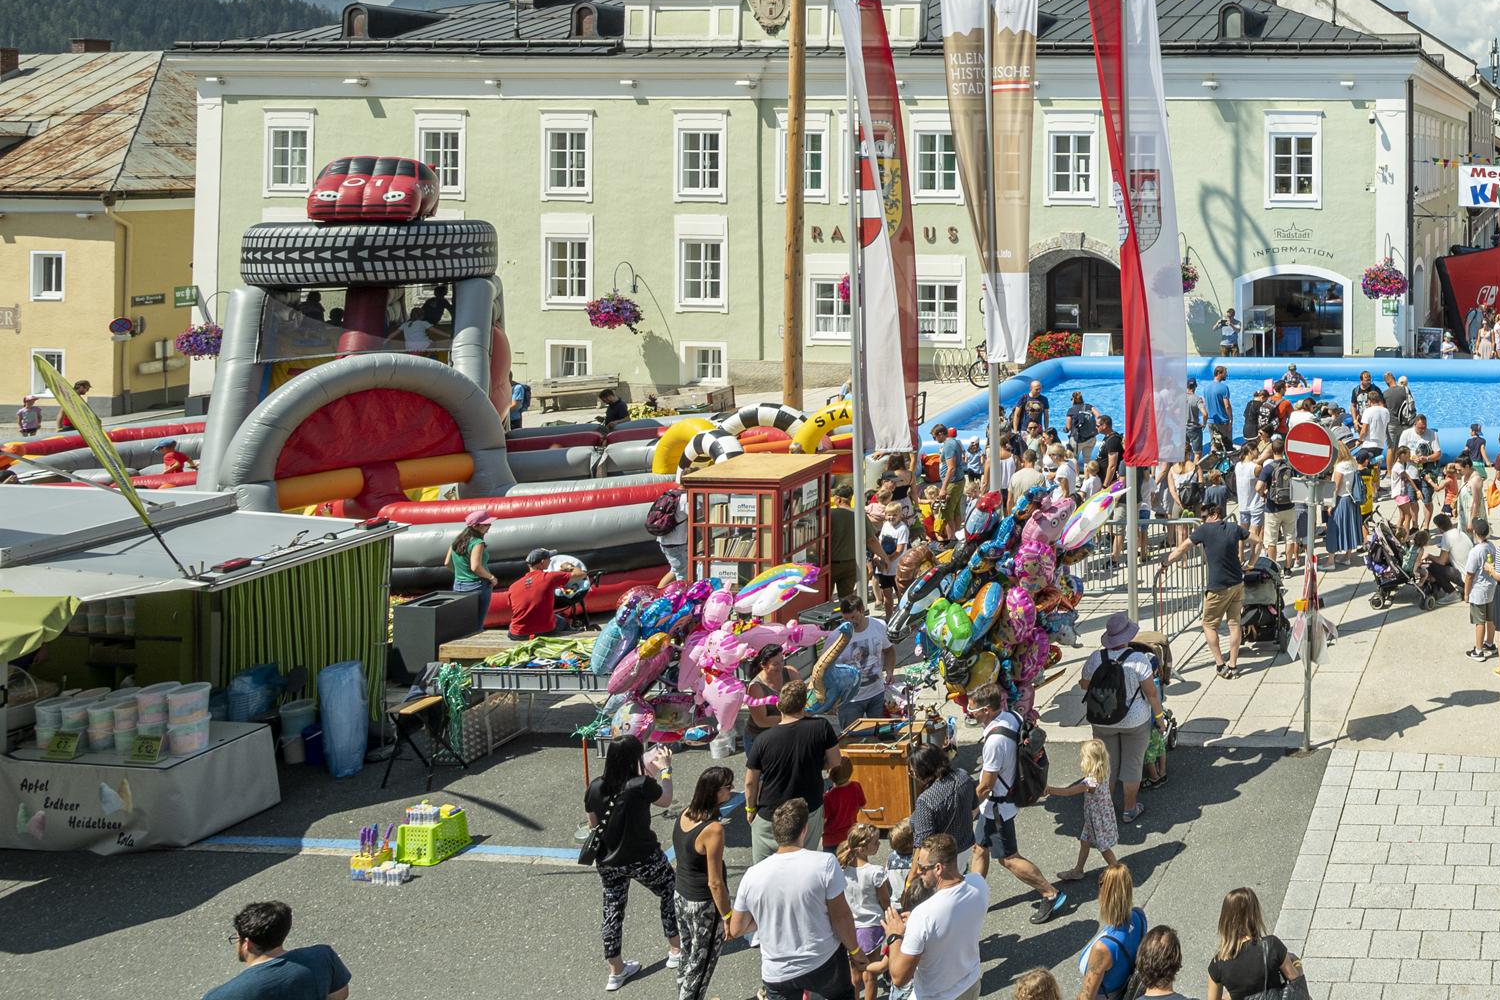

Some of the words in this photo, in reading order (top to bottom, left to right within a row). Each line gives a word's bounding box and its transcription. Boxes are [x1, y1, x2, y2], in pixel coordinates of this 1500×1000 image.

[950, 52, 985, 65] KLEIN
[951, 65, 1030, 80] HISTISCHE
[951, 82, 985, 95] STAD
[810, 225, 960, 244] RAAUS
[1276, 230, 1311, 239] Radstadt
[1252, 246, 1335, 259] INFORMATION
[814, 408, 849, 428] STA
[20, 778, 49, 794] Apfel
[43, 797, 80, 811] Erdbeer
[68, 815, 122, 830] Heidelbeer
